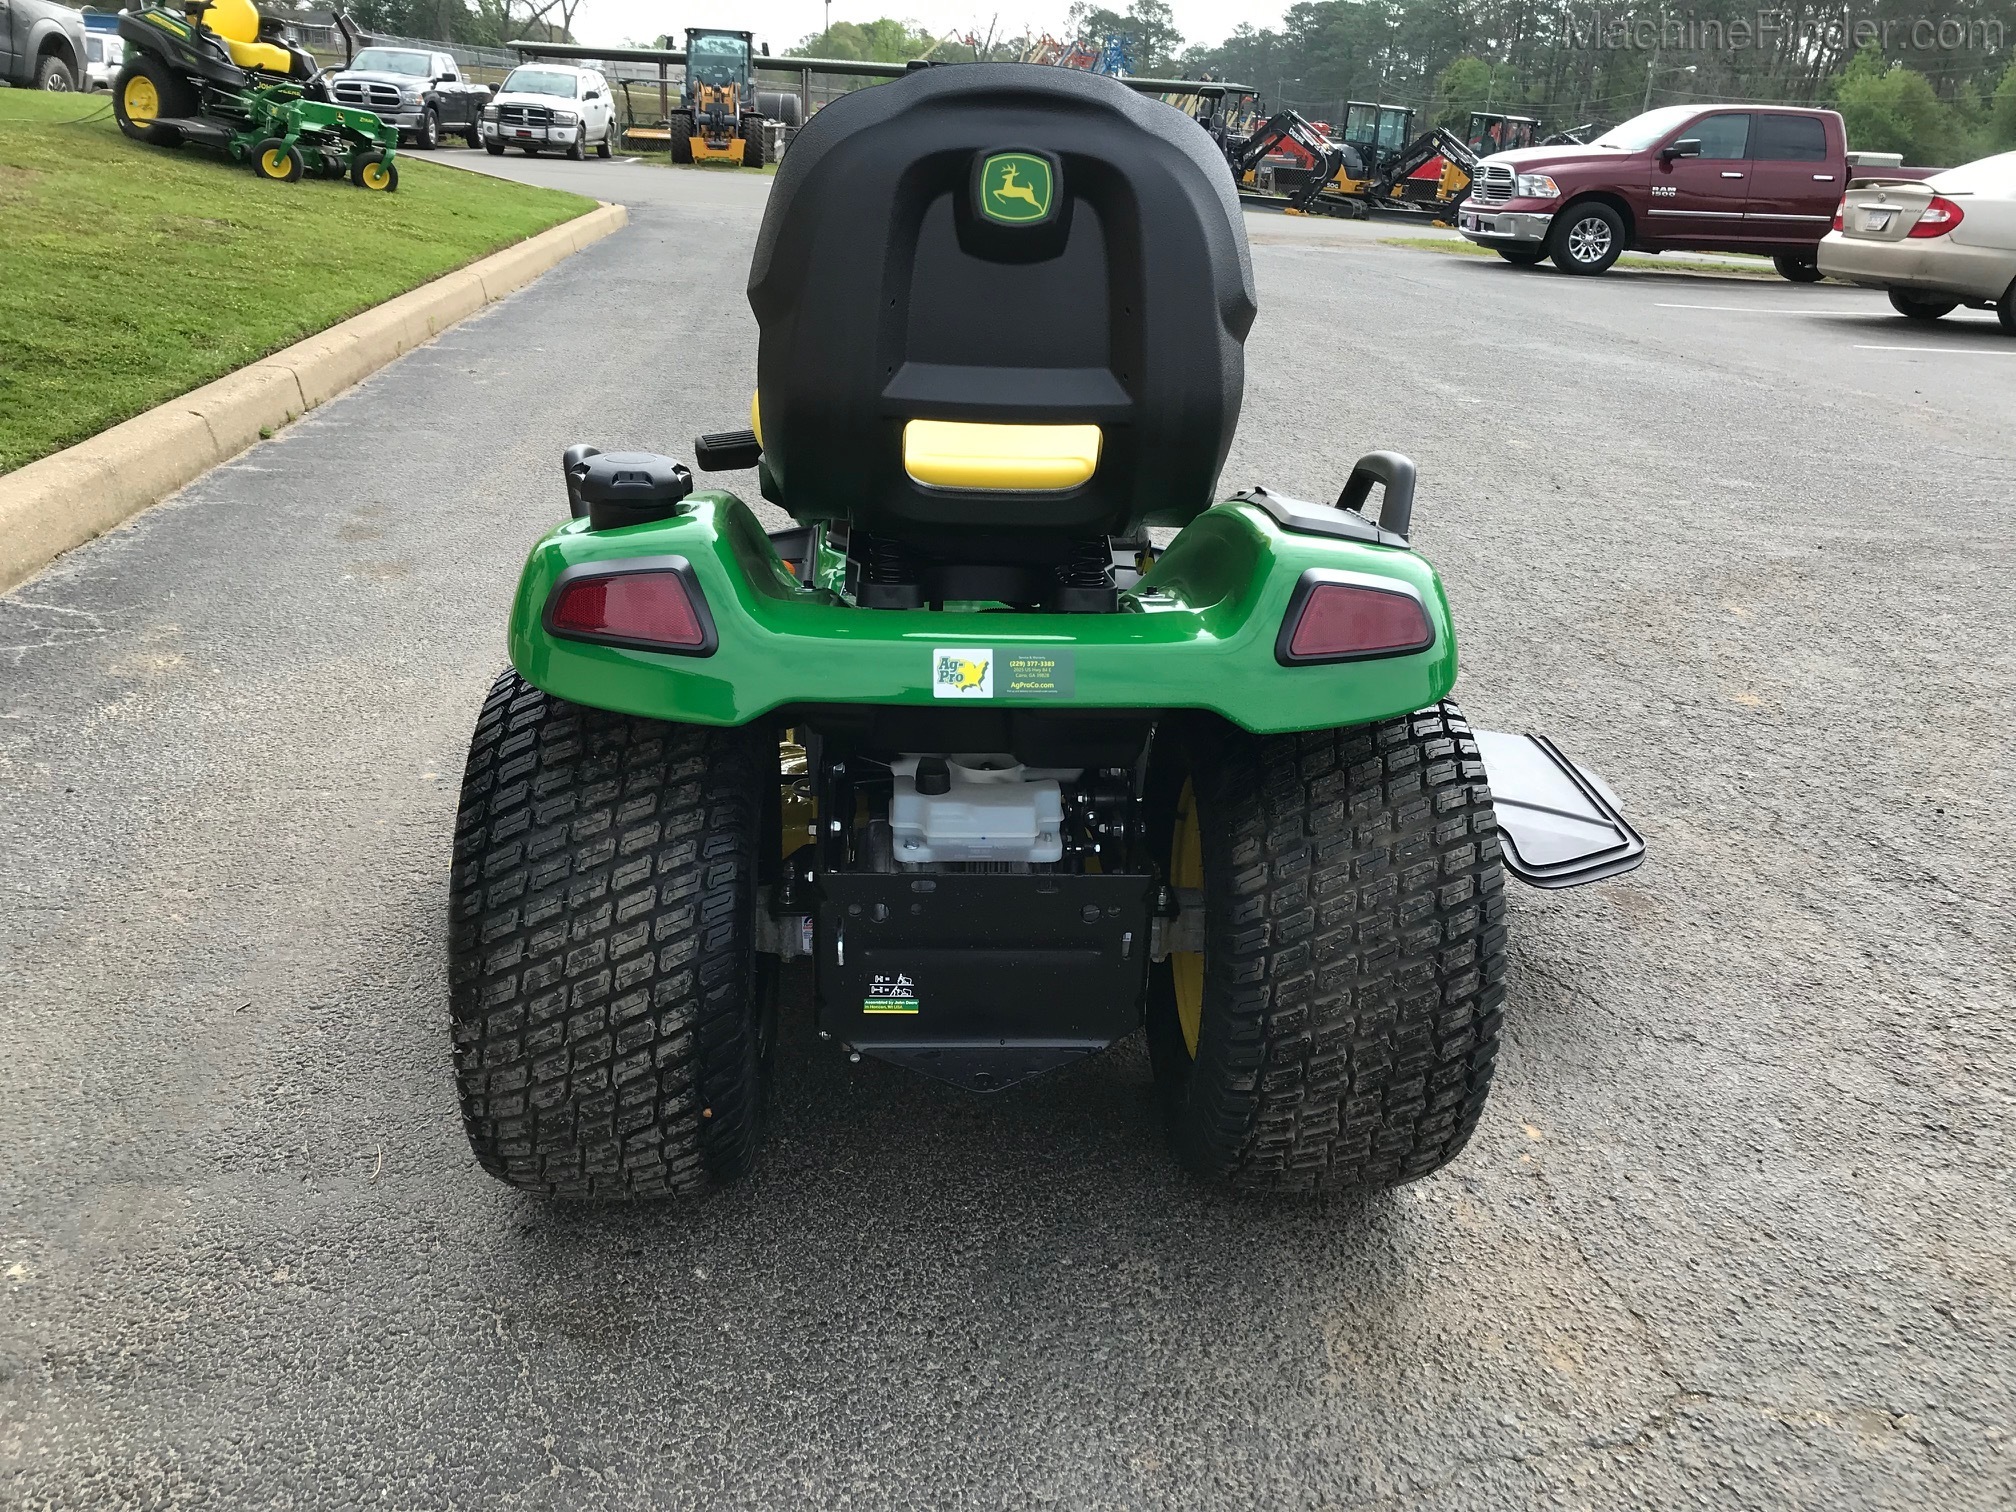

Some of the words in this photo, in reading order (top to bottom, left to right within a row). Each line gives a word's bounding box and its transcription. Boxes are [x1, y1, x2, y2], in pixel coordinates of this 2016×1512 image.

[1288, 127, 1305, 145] DEERE
[1440, 145, 1458, 163] DEERE
[938, 657, 964, 672] Ag-
[1009, 660, 1026, 668] (229)
[938, 671, 964, 683] Pro
[1010, 681, 1055, 689] AgProCo.com
